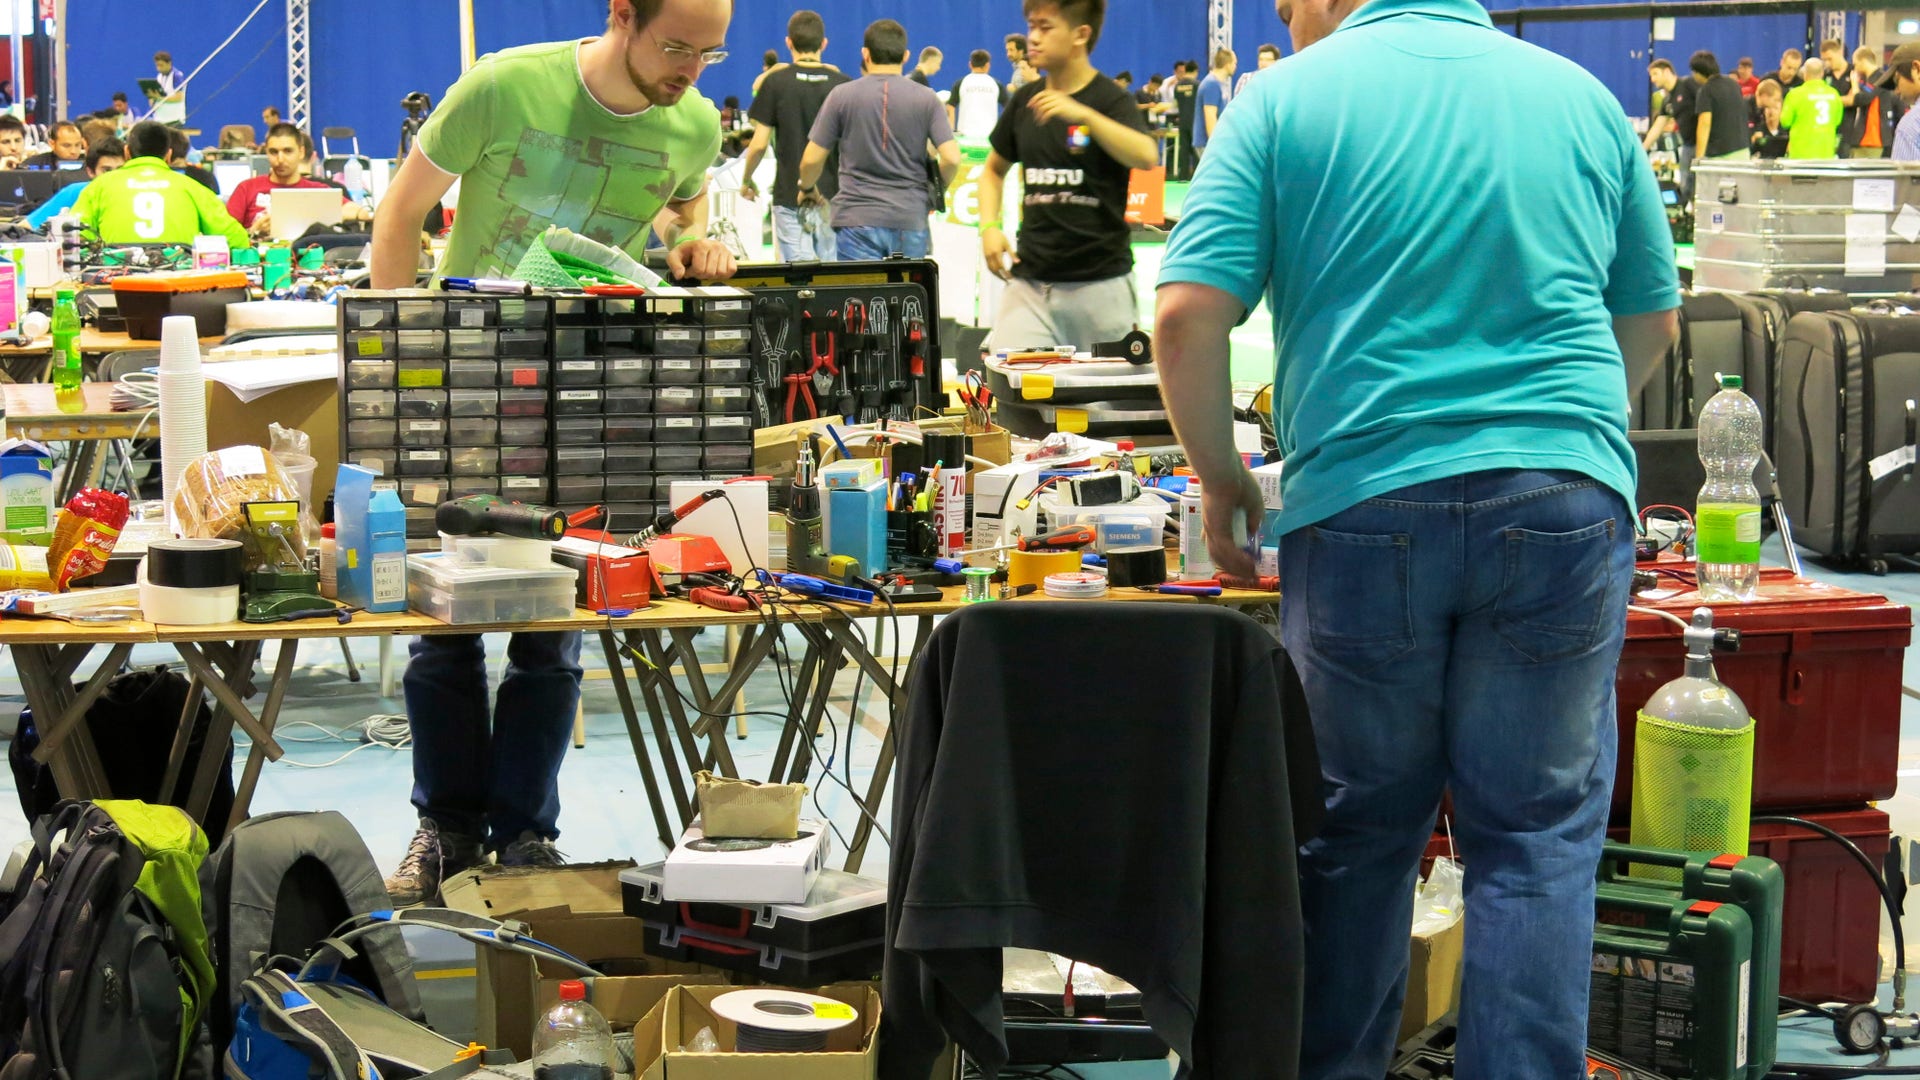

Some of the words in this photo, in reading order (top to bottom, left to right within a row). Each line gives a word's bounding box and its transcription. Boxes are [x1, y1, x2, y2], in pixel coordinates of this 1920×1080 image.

[1815, 100, 1830, 125] 3
[1025, 167, 1084, 186] BISTU
[133, 191, 165, 239] 9
[950, 475, 964, 497] 70
